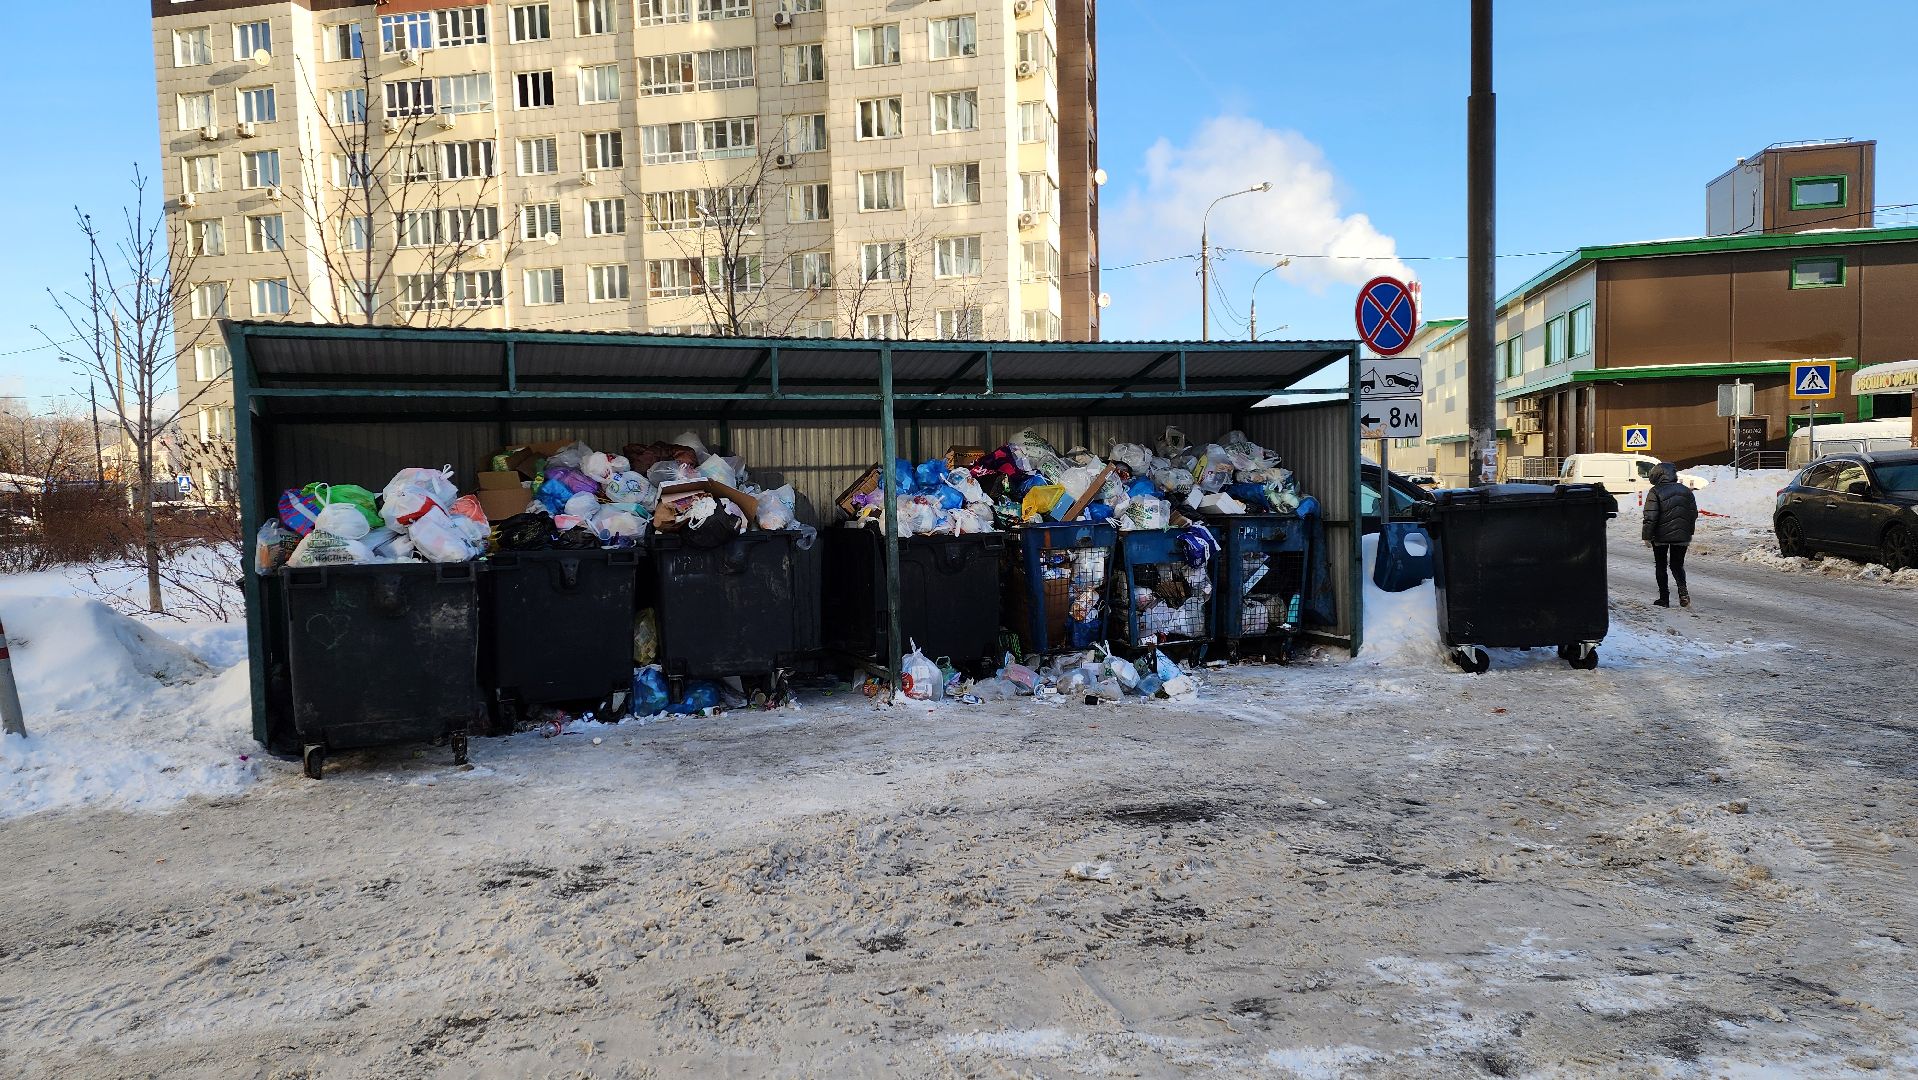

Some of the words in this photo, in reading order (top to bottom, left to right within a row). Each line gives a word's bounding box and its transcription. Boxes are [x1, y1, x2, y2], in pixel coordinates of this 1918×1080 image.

[1855, 374, 1885, 391] ОВОЩИ
[1892, 370, 1918, 387] ФРУК
[1389, 407, 1401, 429] 8
